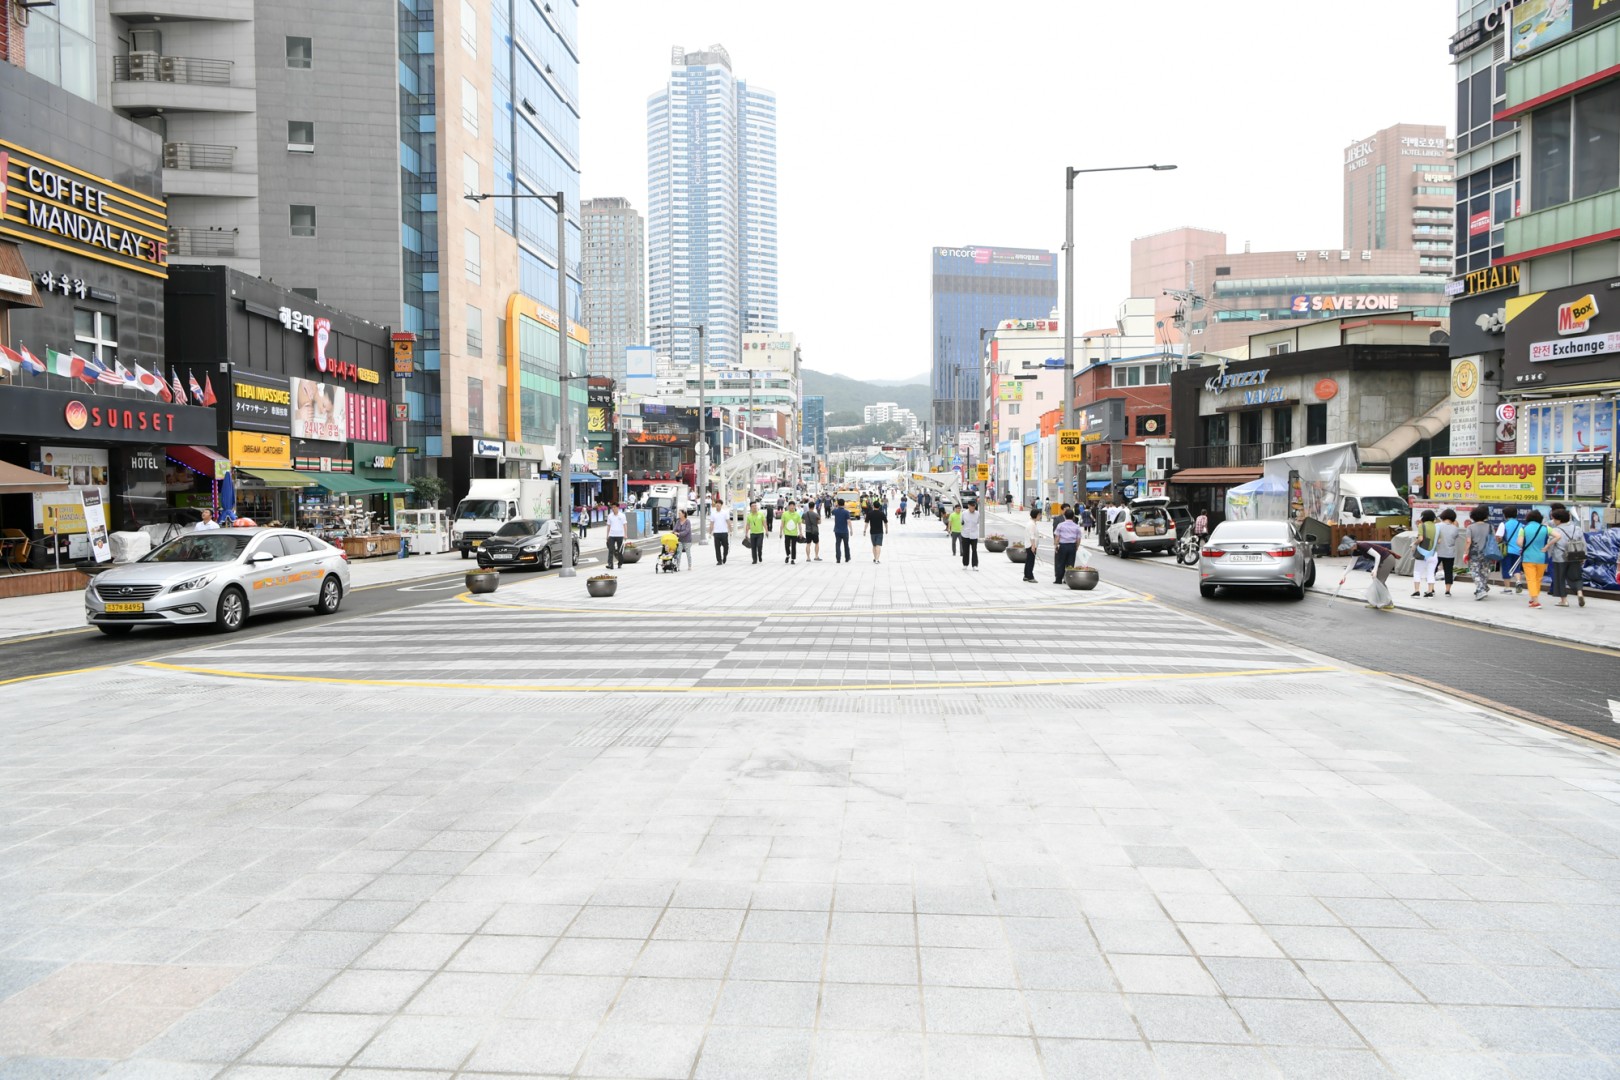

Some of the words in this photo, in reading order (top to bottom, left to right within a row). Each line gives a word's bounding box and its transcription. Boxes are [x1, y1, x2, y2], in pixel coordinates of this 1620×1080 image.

[1349, 157, 1369, 172] HOTEL
[28, 166, 109, 217] COFFEE
[29, 199, 143, 257] MANDALAY
[147, 240, 167, 263] 3F
[41, 271, 87, 299] 아우라
[1466, 265, 1508, 294] THAI
[1312, 296, 1353, 310] SAVE
[1356, 295, 1398, 310] ZONE
[1573, 303, 1592, 319] Box
[278, 306, 314, 337] 해운대
[1533, 345, 1551, 358] 환전
[1553, 341, 1605, 356] Exchange
[327, 358, 357, 383] 마사지
[1221, 369, 1270, 388] FUZZY
[235, 383, 255, 400] THAI
[256, 386, 290, 405] MASSAGE
[1243, 387, 1288, 405] NAVEL
[91, 407, 175, 432] SUNSET
[304, 421, 325, 436] 24시간
[327, 423, 339, 436] 영업
[71, 453, 96, 463] HOTEL
[243, 445, 261, 453] DREAM
[263, 446, 283, 454] CATCHER
[131, 457, 159, 470] HOTEL
[374, 455, 396, 469] SUBWAY
[1434, 462, 1474, 479] Money
[1477, 460, 1537, 479] Exchange
[124, 603, 141, 611] 8495
